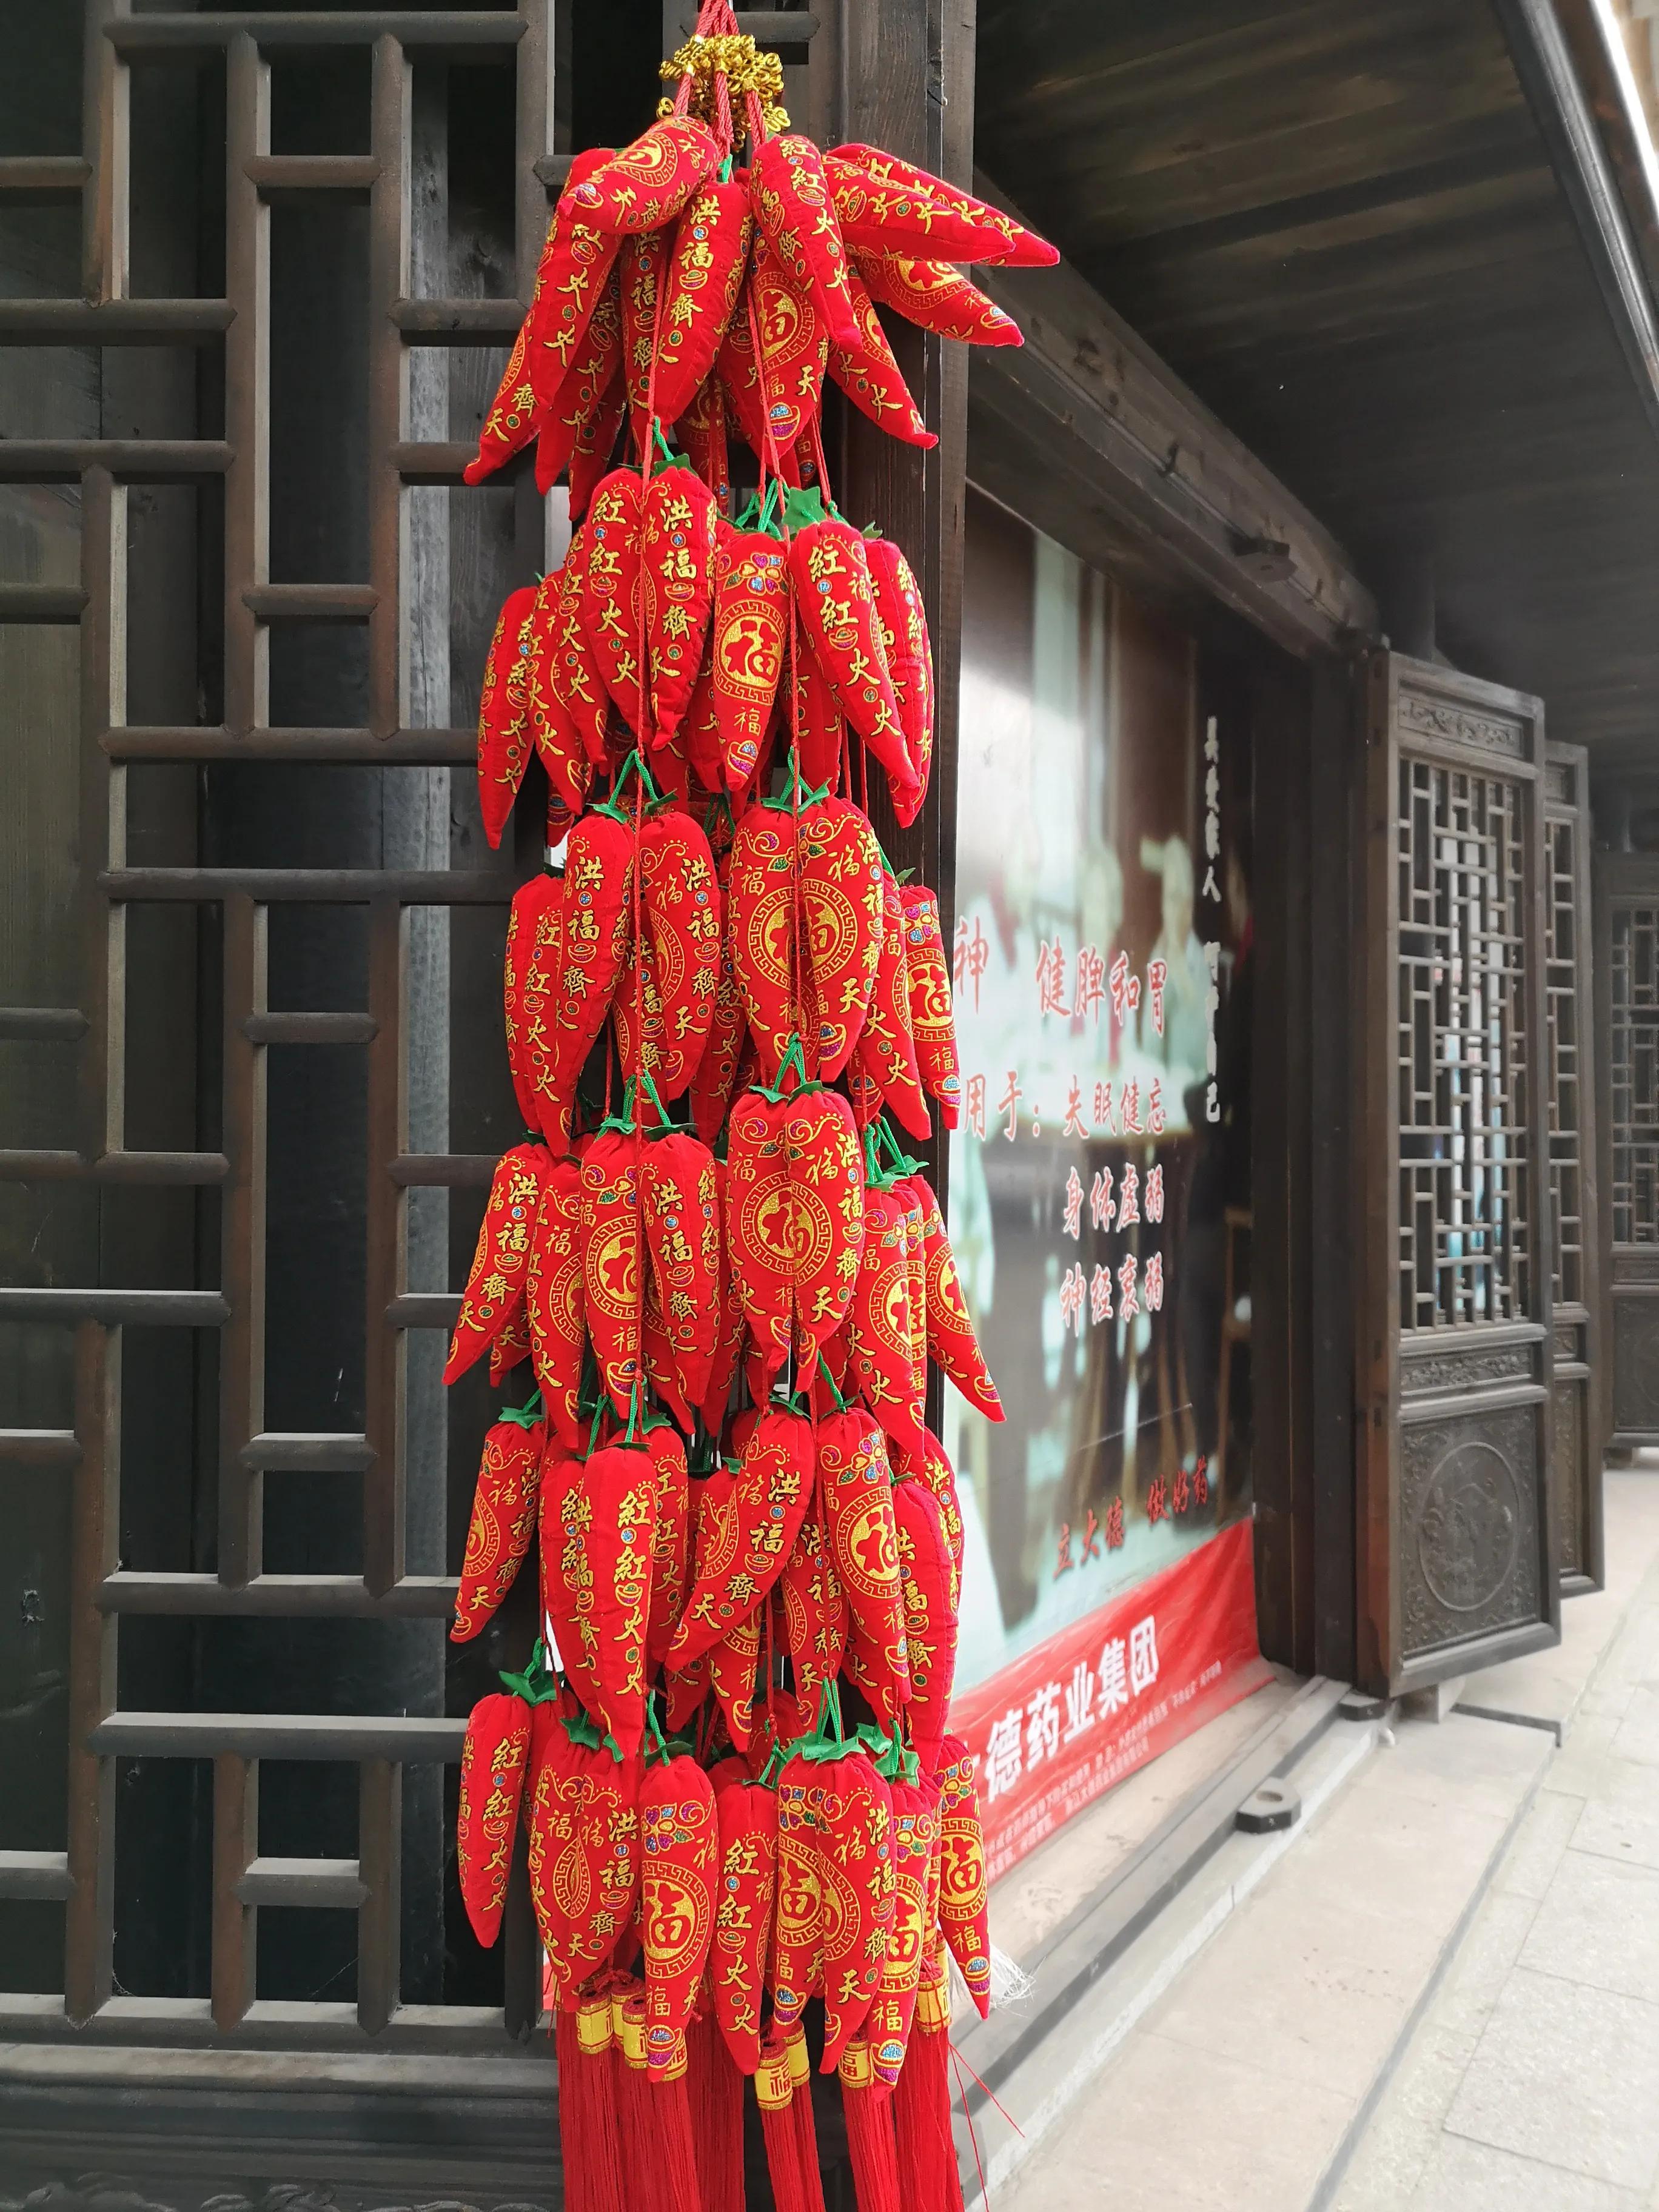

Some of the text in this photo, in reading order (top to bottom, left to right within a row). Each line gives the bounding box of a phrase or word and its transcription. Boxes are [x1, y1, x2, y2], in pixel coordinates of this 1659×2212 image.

[778, 139, 850, 305] 紅紅火火
[591, 491, 642, 689] 紅紅火火
[808, 546, 902, 737] 紅紅火火
[734, 706, 762, 736] 福
[656, 873, 685, 910] 福
[742, 862, 766, 896] 福
[828, 844, 860, 883] 福
[674, 854, 720, 1041] 洪福齊天
[839, 829, 884, 1014] 洪福齊天
[524, 911, 561, 1102] 紅紅火火
[1036, 934, 1168, 1038] 健脾和胃
[929, 1047, 955, 1073] 福
[1062, 1073, 1167, 1141] 失眠健忘
[732, 1151, 757, 1183] 福
[804, 1146, 839, 1187] 福
[1062, 1161, 1165, 1241] 身体虚弱
[457, 1172, 540, 1333] 洪福齊天
[546, 1225, 572, 1258] 福
[811, 1131, 863, 1324] 洪福齊天
[1059, 1251, 1164, 1338] 神经衰弱
[611, 1326, 638, 1353] 福
[488, 1479, 518, 1508] 福
[738, 1472, 765, 1506] 福
[691, 1469, 802, 1631] 洪福齊天
[613, 1489, 652, 1697] 紅紅火火
[964, 1614, 1160, 1805] 德药业集团
[482, 1737, 523, 1912] 紅紅火火
[547, 1810, 573, 1841] 福
[580, 1815, 604, 1848] 福
[834, 1830, 866, 1867] 福
[566, 1807, 640, 1961] 洪福齊天
[836, 1806, 896, 2006] 洪福齊天
[717, 1838, 760, 2035] 紅紅火火
[953, 1926, 982, 1952] 福
[646, 1985, 671, 2017] 福
[872, 1999, 904, 2033] 福
